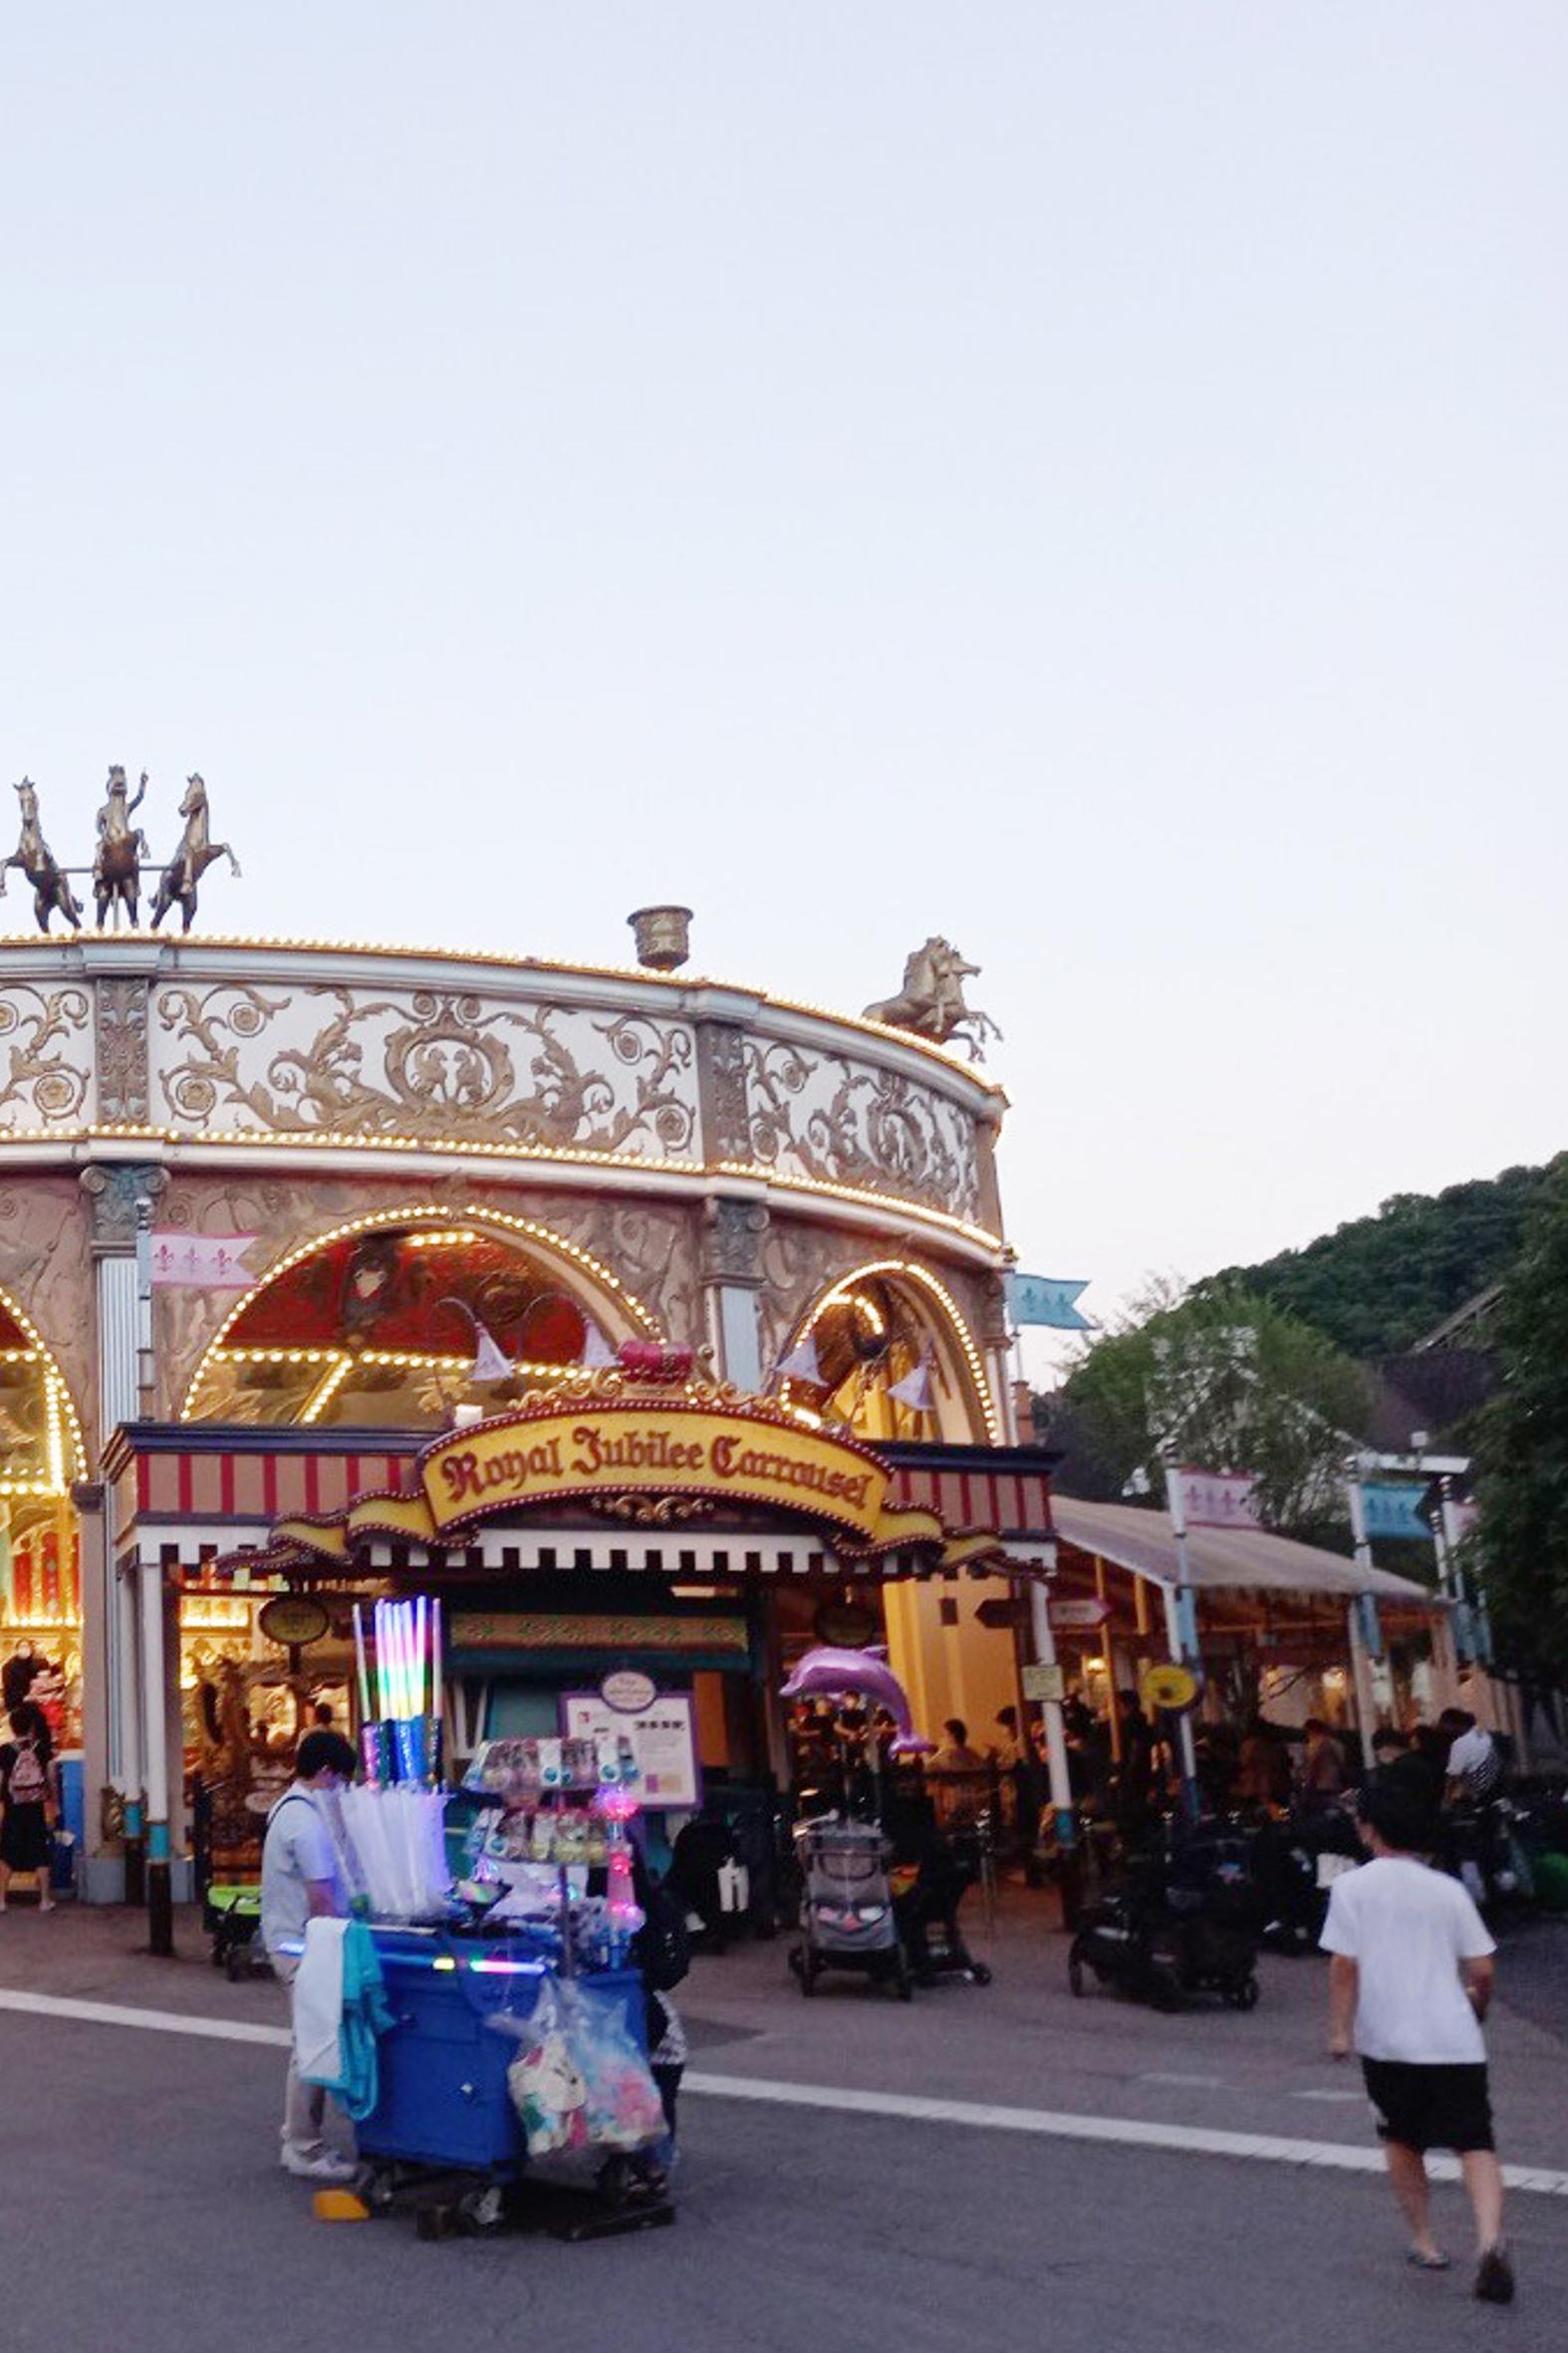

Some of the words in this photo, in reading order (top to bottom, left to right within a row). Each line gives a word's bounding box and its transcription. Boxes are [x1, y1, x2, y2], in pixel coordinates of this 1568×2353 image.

[441, 1436, 564, 1503] Royal
[571, 1426, 703, 1474] Jubilee
[710, 1435, 874, 1510] Carrousel
